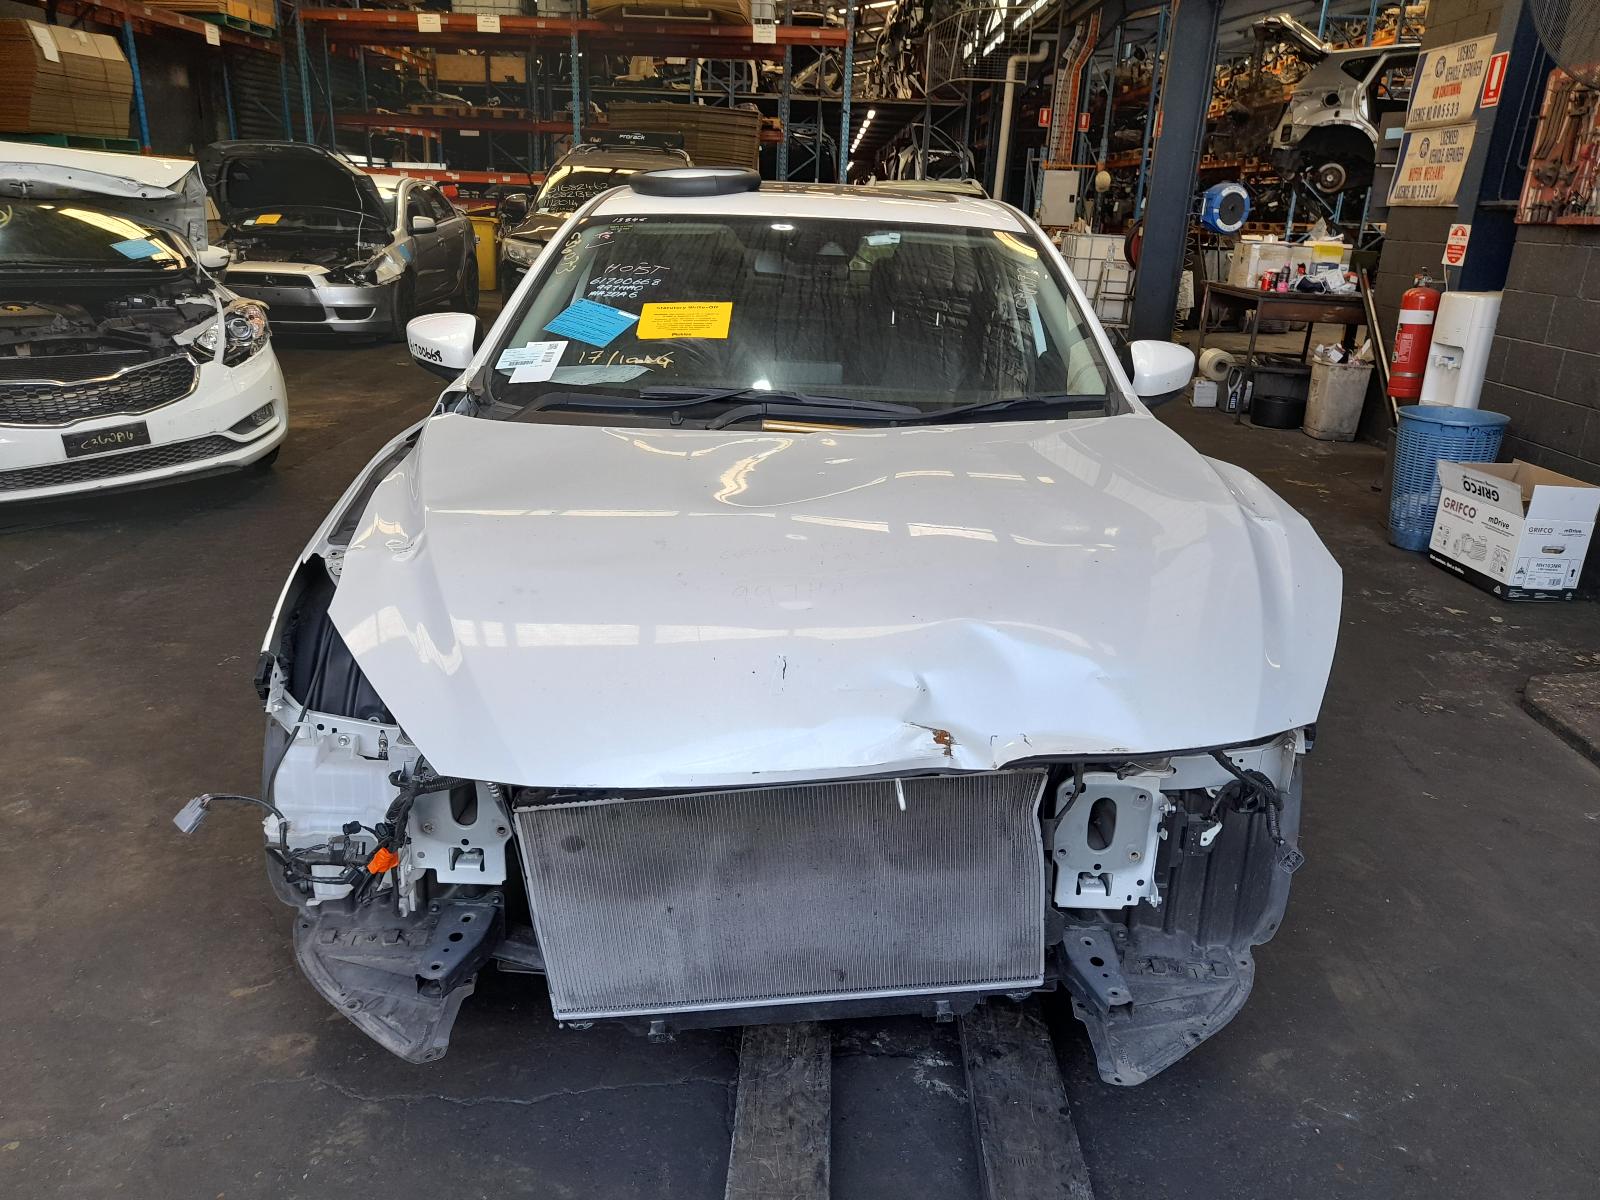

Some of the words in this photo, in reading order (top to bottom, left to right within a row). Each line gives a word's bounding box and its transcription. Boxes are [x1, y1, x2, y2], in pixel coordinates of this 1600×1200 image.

[1456, 42, 1478, 62] LICENSED
[1445, 64, 1462, 82] VEHICLE
[1461, 60, 1483, 80] REPAIRER
[1439, 128, 1460, 146] LICENSED
[1428, 148, 1445, 164] VEHICLE
[1444, 146, 1465, 163] REPAIRER
[1423, 165, 1446, 181] MECHANIC
[1417, 184, 1438, 198] 32621
[1463, 479, 1500, 502] GRIFCO
[1443, 497, 1477, 519] GRIFCO
[1488, 515, 1510, 530] mDrive
[1528, 526, 1553, 534] GRIFCO
